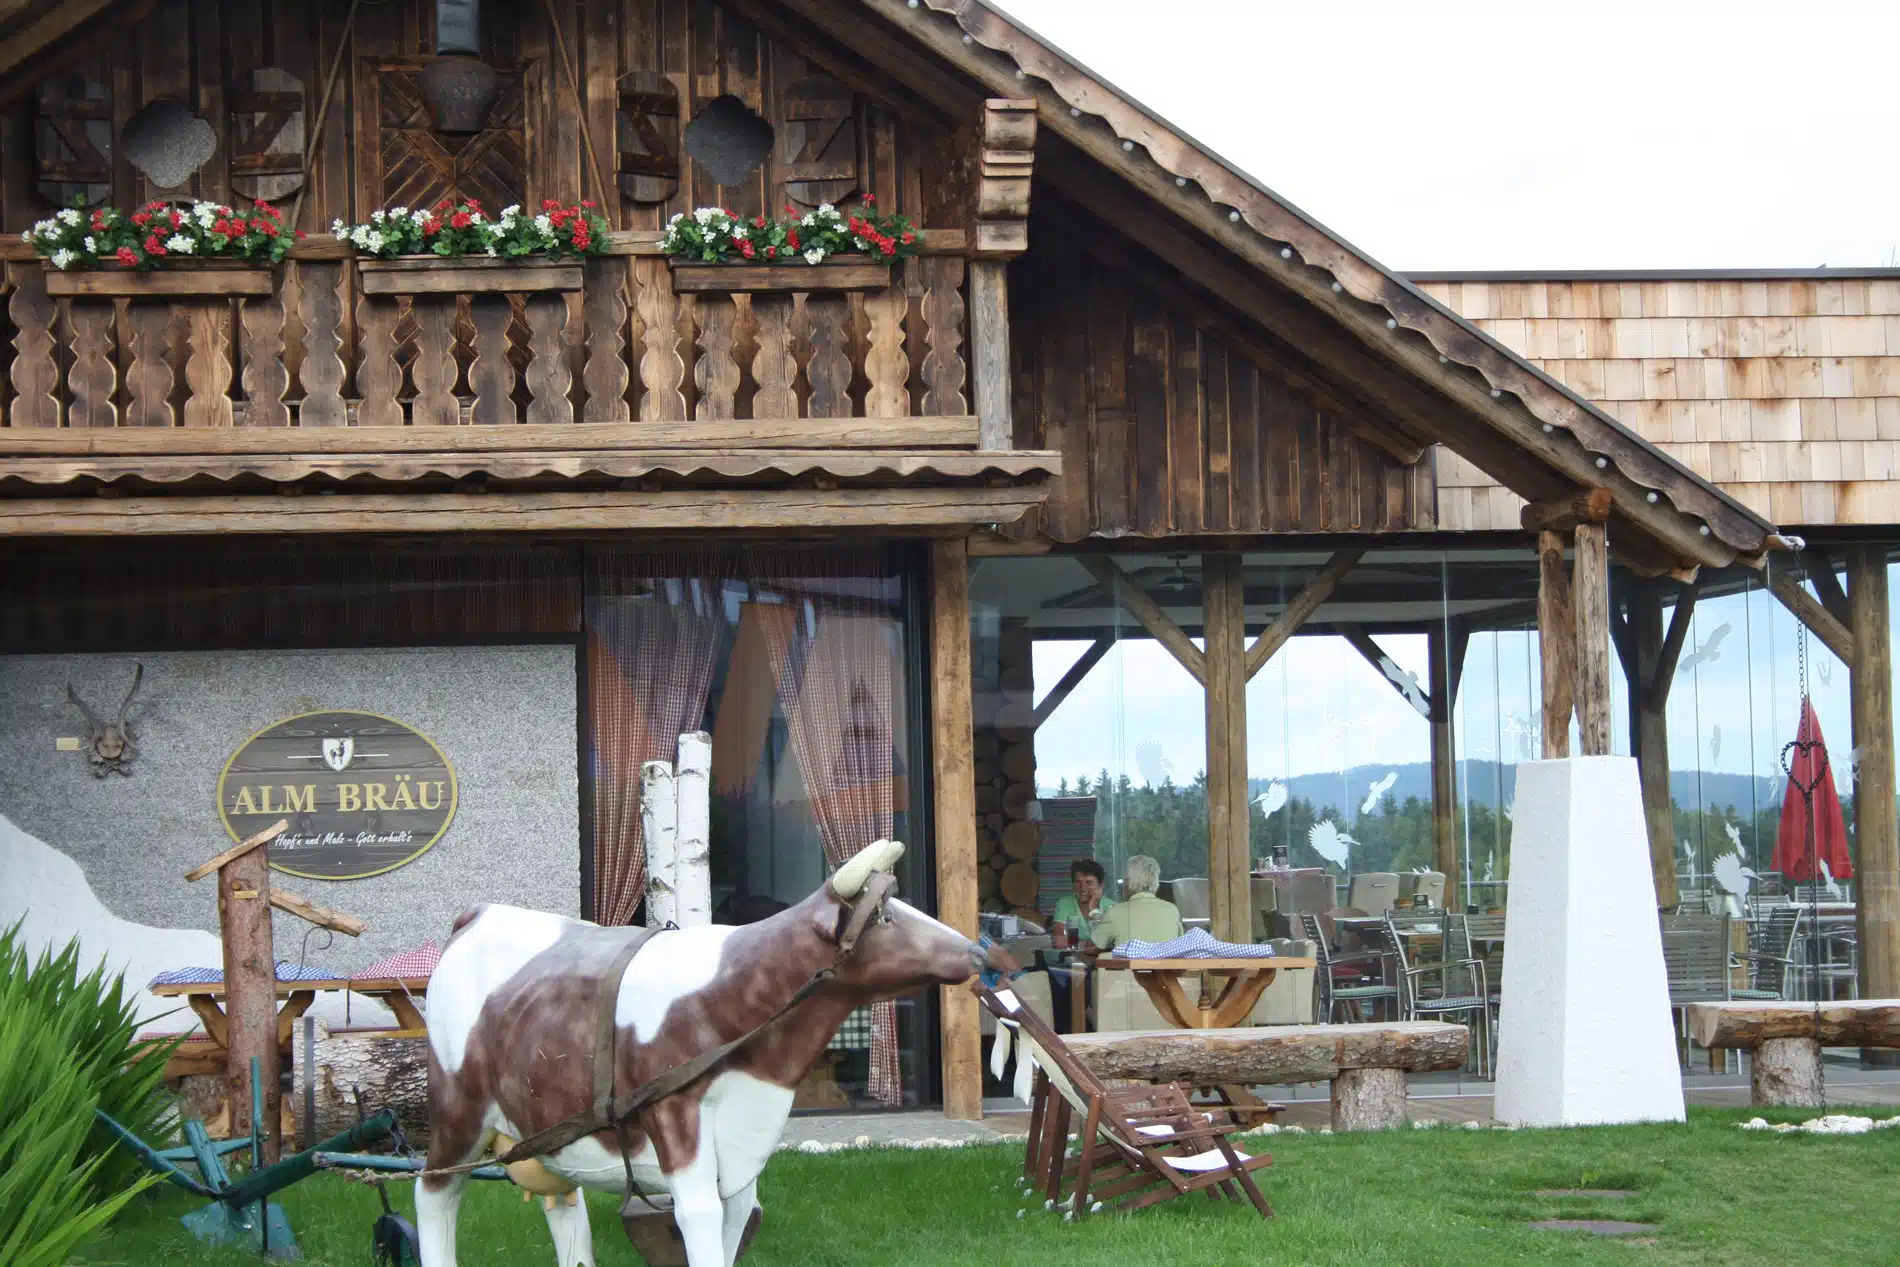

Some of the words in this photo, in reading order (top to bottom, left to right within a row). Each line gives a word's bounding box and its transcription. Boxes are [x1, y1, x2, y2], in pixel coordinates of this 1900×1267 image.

[229, 784, 317, 815] ALM
[336, 774, 445, 812] BRÄU
[322, 832, 345, 845] Malz
[356, 831, 376, 847] Gott
